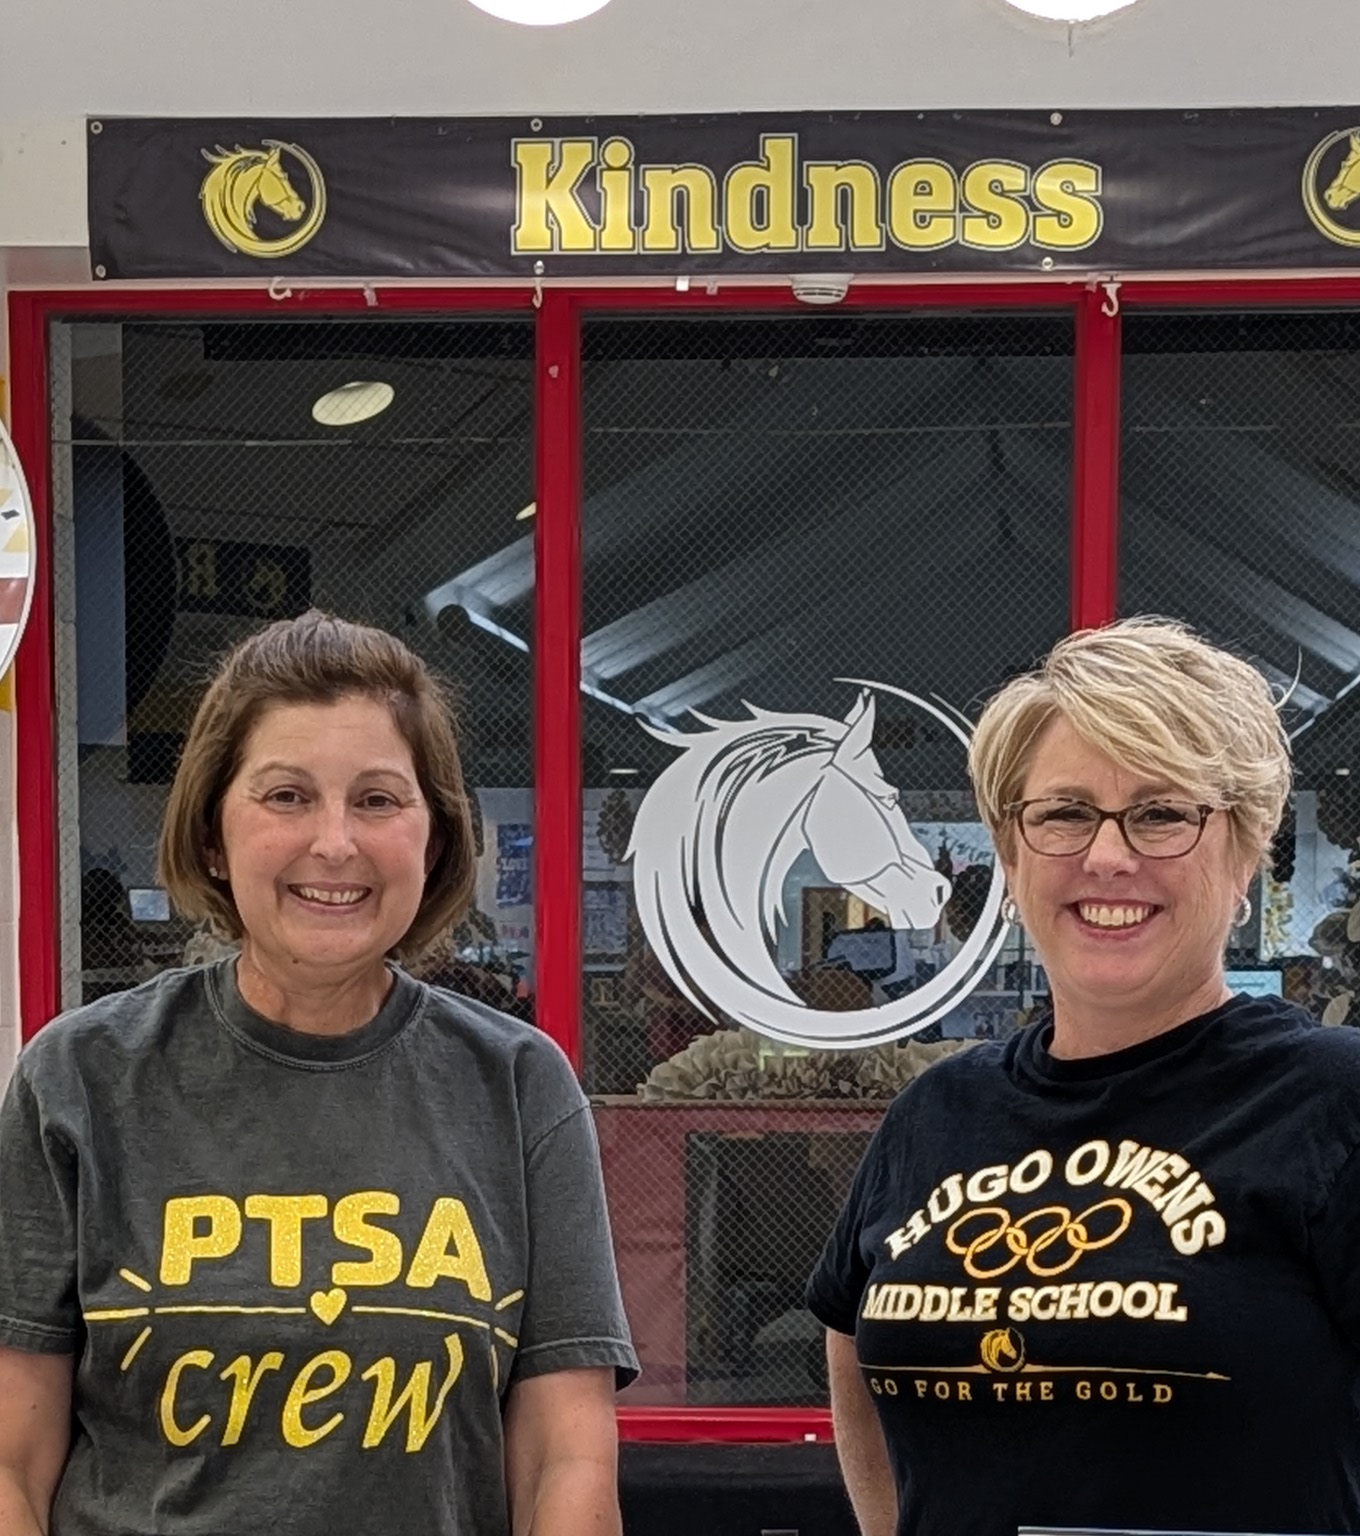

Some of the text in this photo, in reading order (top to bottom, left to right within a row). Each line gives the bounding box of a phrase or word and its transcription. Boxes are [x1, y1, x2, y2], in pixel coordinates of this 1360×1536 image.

[510, 132, 1104, 256] Kindness
[159, 1191, 492, 1301] PTSA
[883, 1140, 1227, 1261] HUGO OWENS
[862, 1282, 1188, 1322] MIDDLE SCHOOL
[160, 1333, 463, 1453] crew
[871, 1378, 1173, 1403] GO FOR THE GOLD
